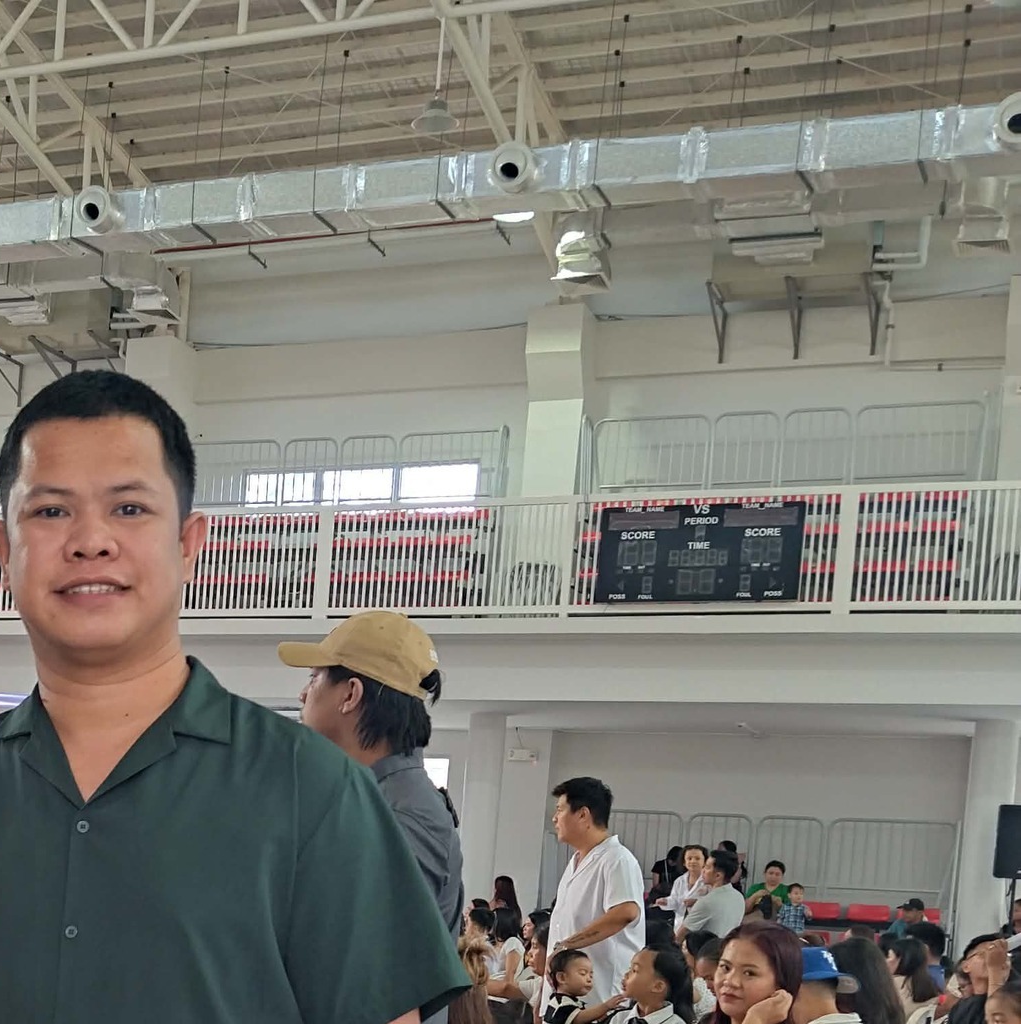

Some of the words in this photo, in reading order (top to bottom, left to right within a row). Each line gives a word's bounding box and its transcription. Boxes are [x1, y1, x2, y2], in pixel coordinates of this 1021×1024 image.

[694, 505, 710, 515] VS
[684, 517, 719, 526] PERIOD
[621, 531, 656, 540] SCORE
[744, 528, 782, 538] SCORE
[687, 542, 711, 550] TIME
